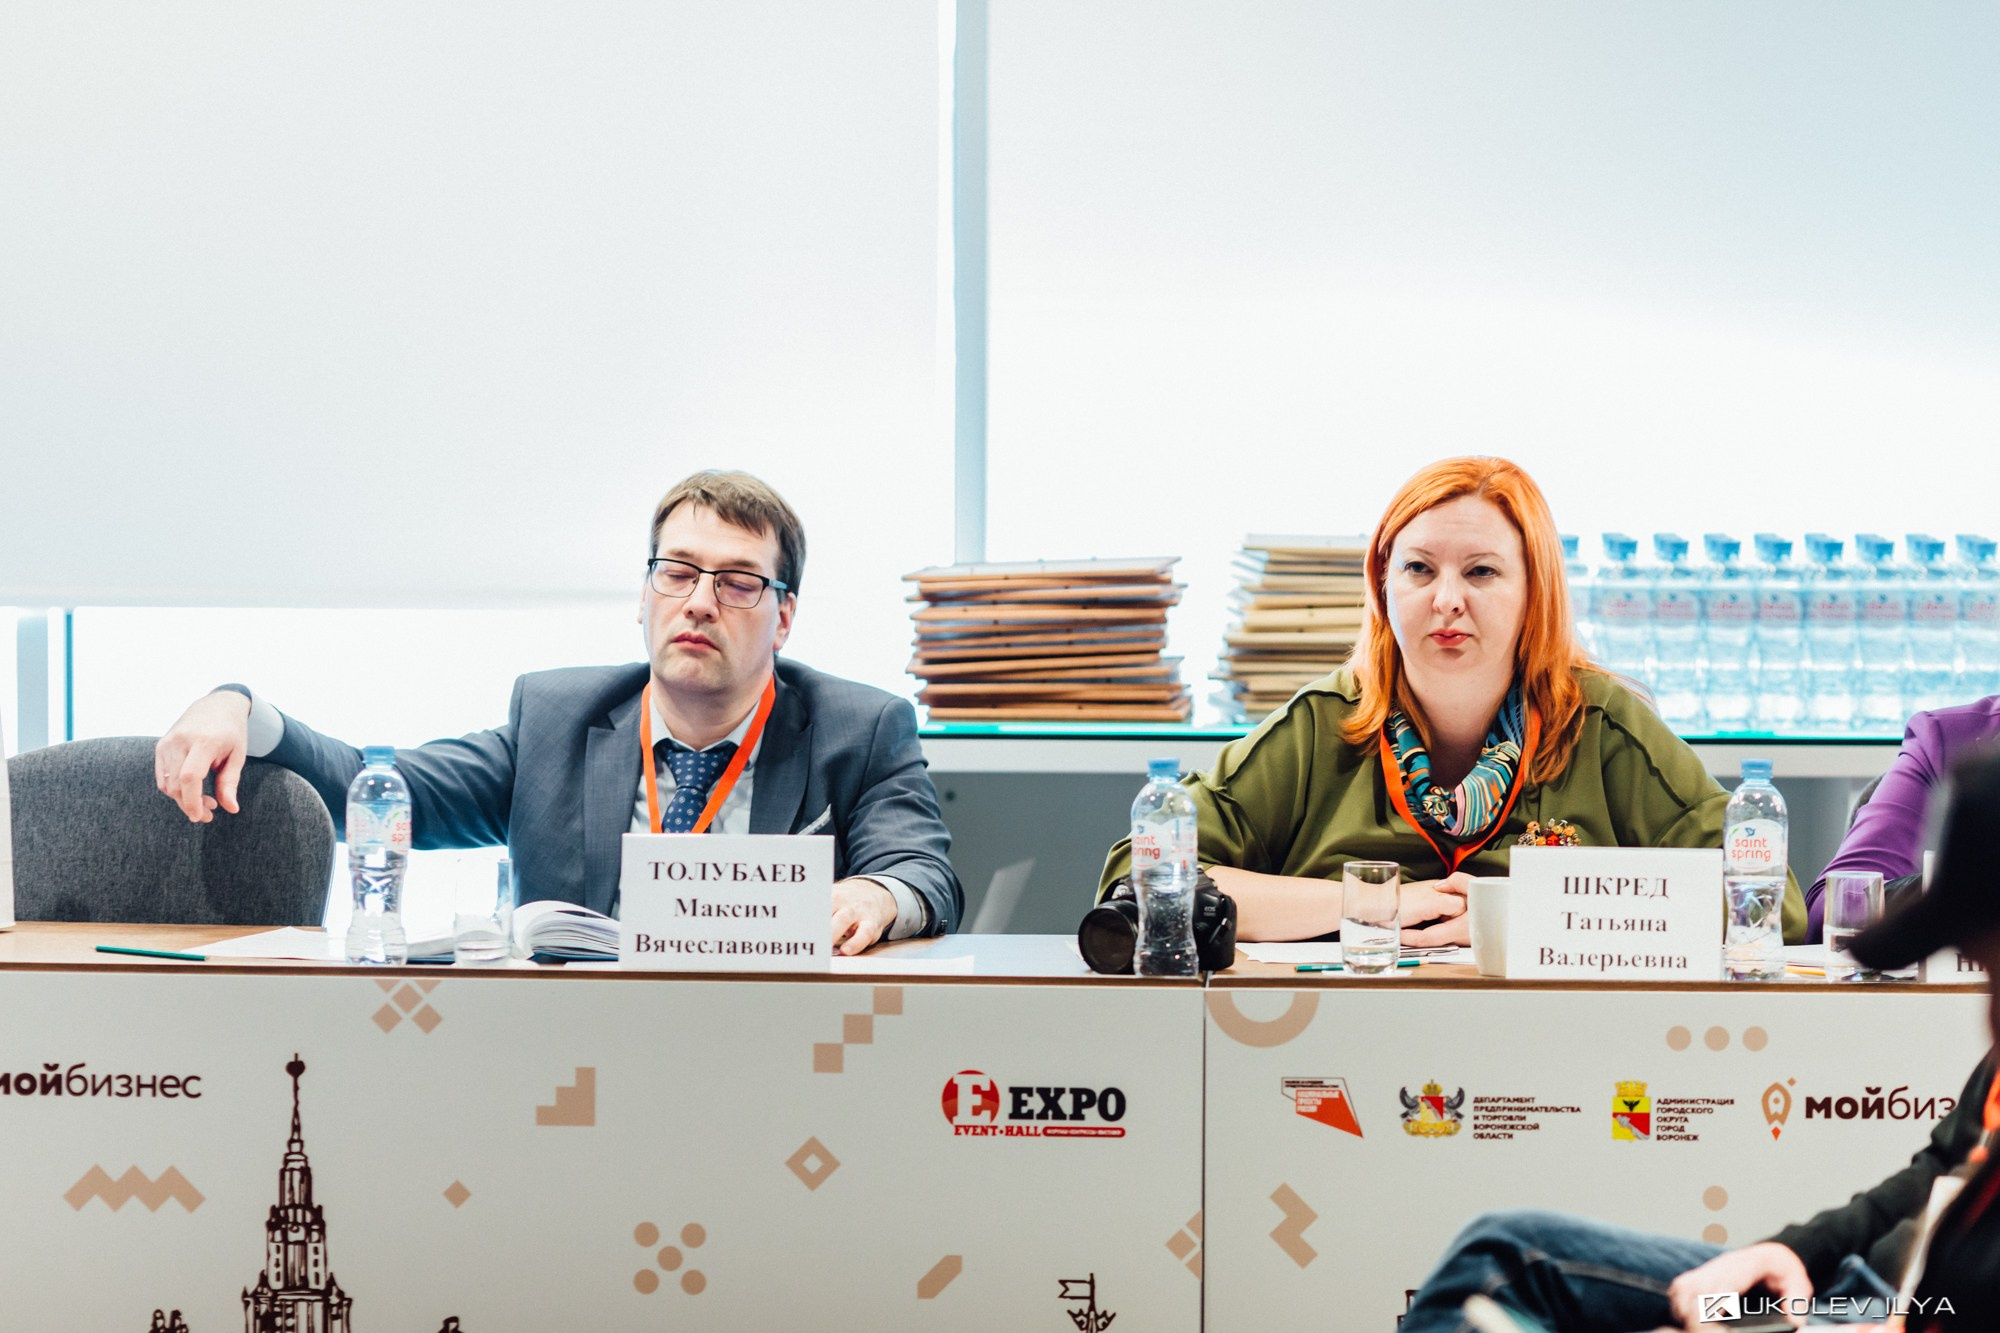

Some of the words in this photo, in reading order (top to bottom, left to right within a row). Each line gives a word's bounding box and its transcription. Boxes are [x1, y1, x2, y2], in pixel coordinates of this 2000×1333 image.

[1735, 837, 1768, 848] saint
[1731, 849, 1772, 862] spring
[647, 861, 807, 883] ТОЛУБАЕВ
[1563, 876, 1670, 899] ШКРЕД
[674, 898, 778, 918] Максим
[1561, 911, 1668, 932] Татьяна
[635, 933, 815, 956] Вячеславович
[1539, 947, 1688, 971] Валерьевна
[1008, 1086, 1127, 1122] EXPO
[1473, 1096, 1536, 1105] ДЕПАРТАМЕНТ
[1656, 1098, 1735, 1106] АДМИНИСТРАЦИЯ
[1805, 1085, 1956, 1120] мойбиз
[1473, 1105, 1581, 1114] ПРЕДПРИНИМАТЕЛЬСТВА
[1656, 1107, 1714, 1115] ГОРОДСКОГО
[1481, 1115, 1527, 1123] ТОРГОВЛИ
[1656, 1116, 1689, 1124] ОКРУГА
[1473, 1123, 1540, 1132] ВОРОНЕЖСКОЙ
[1656, 1125, 1685, 1133] ГОРОД
[1473, 1132, 1514, 1141] ОБЛАСТИ
[1656, 1134, 1699, 1142] ВОРОНЕЖ
